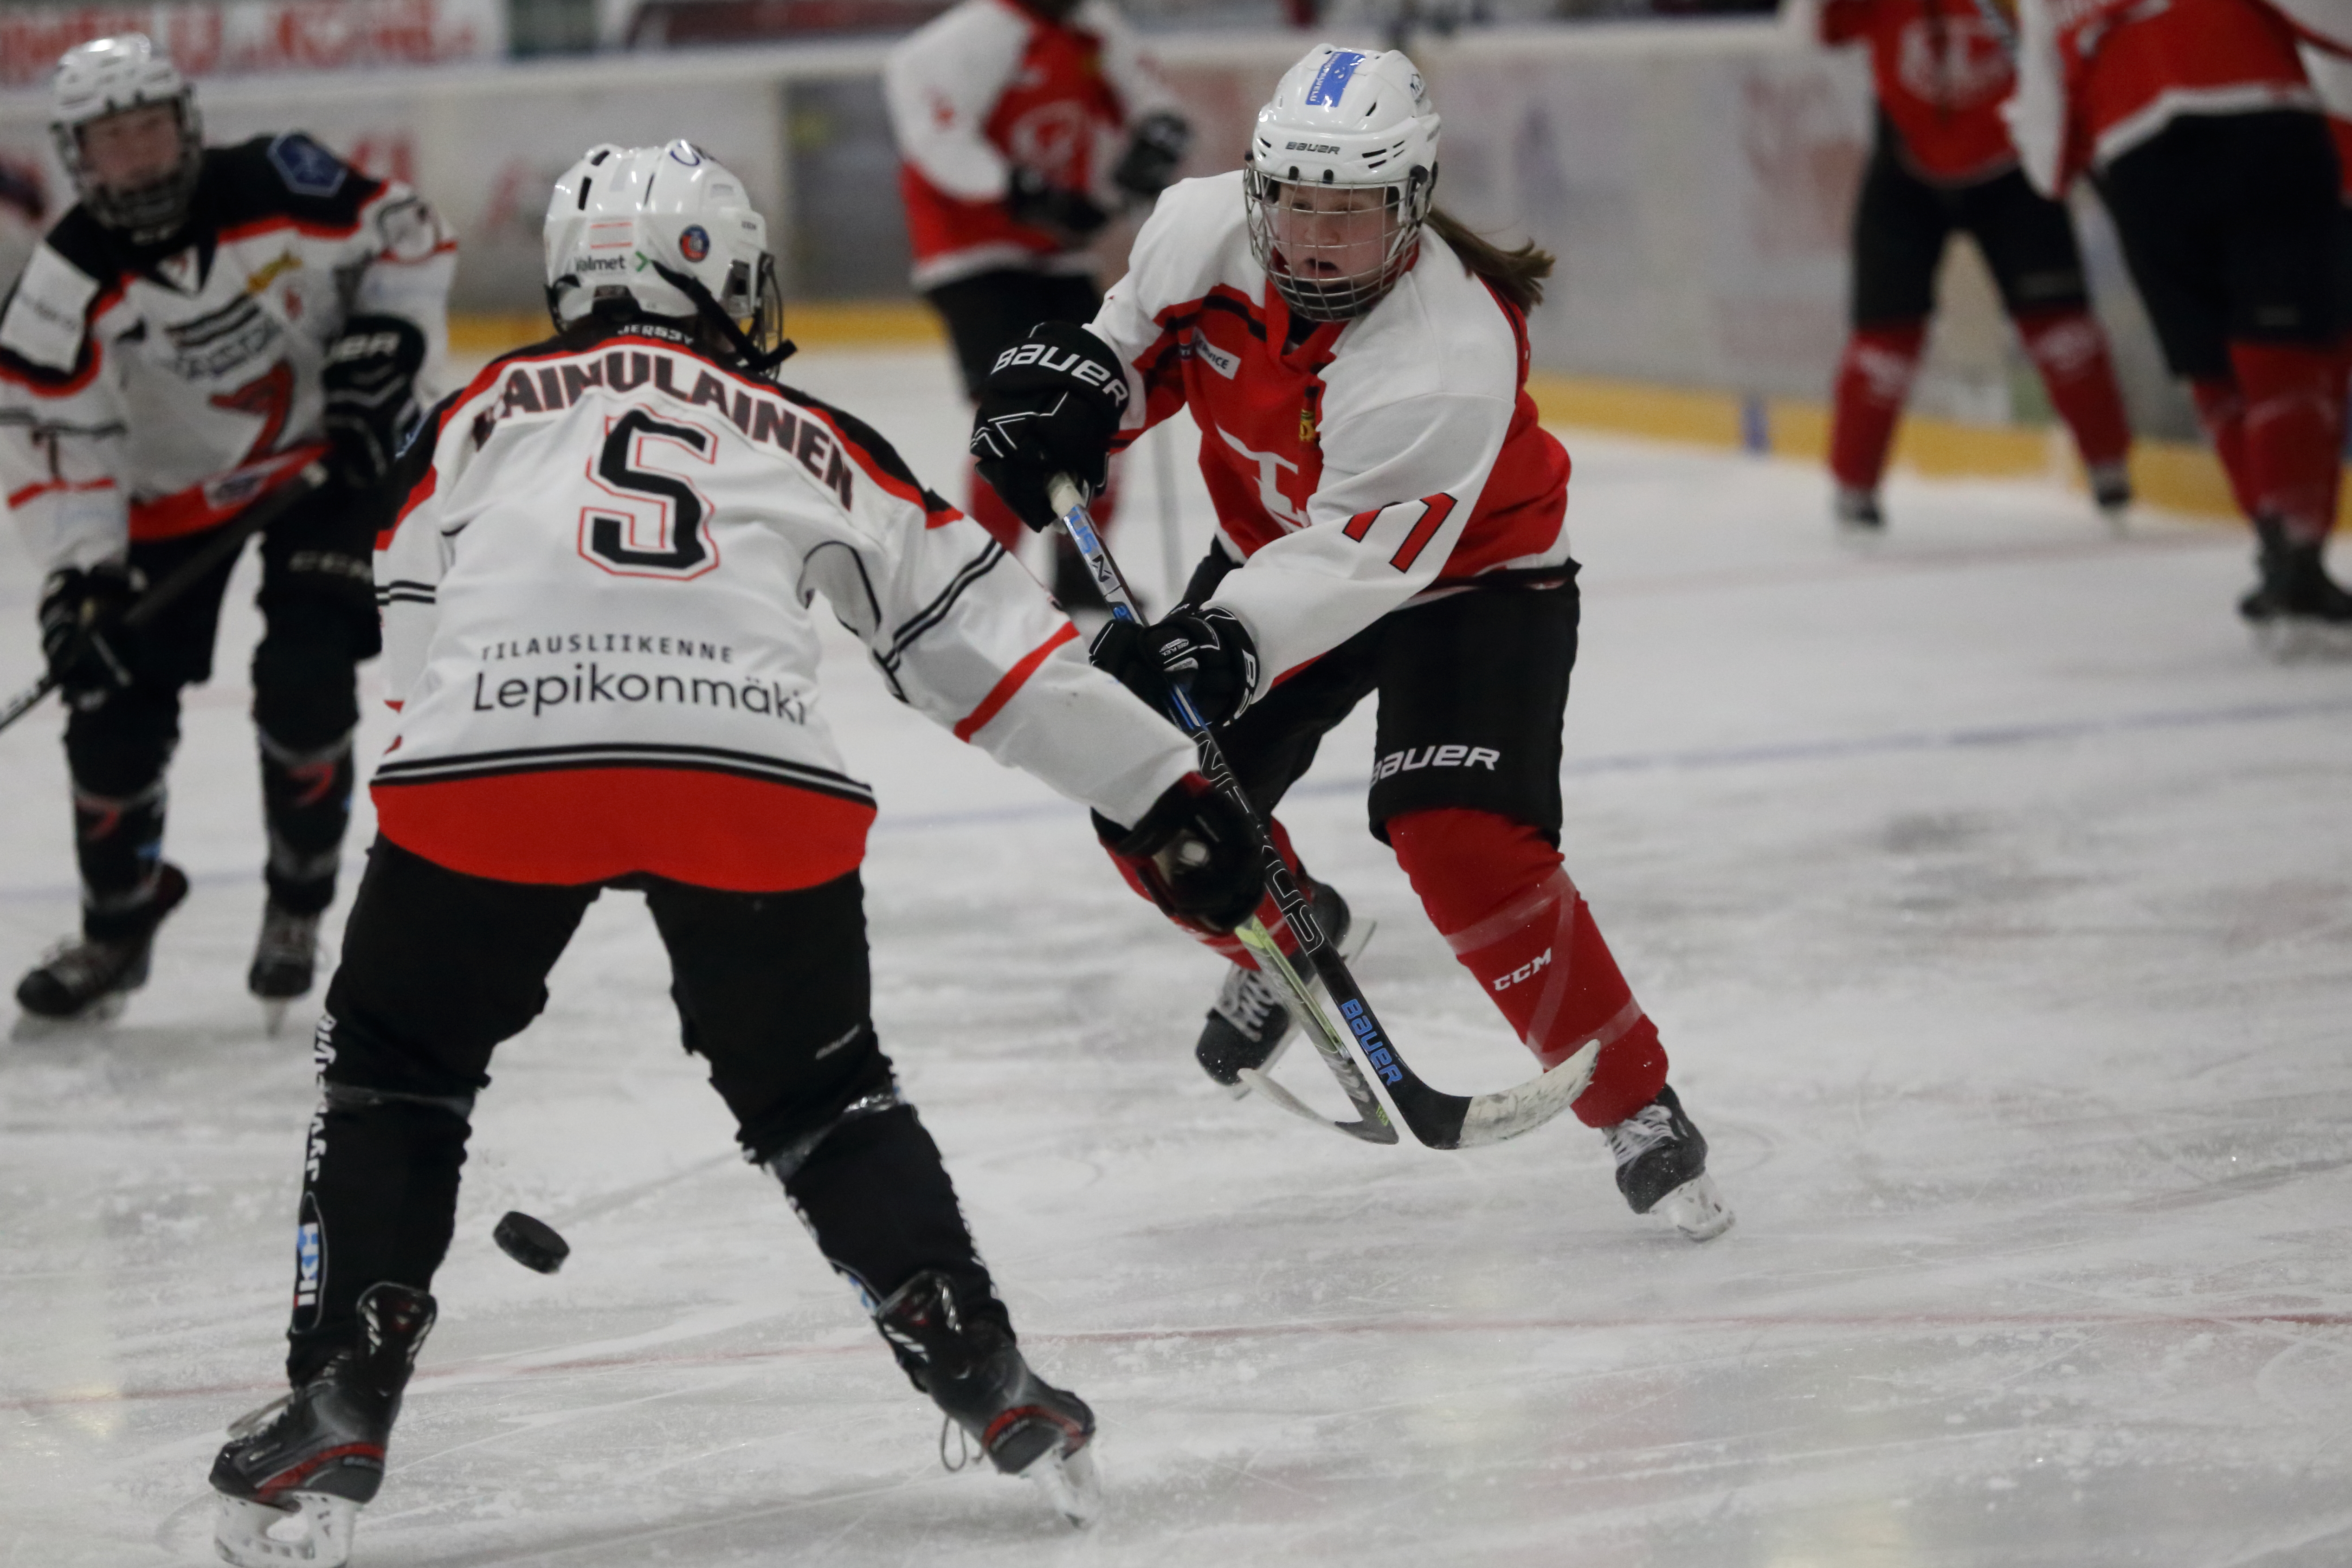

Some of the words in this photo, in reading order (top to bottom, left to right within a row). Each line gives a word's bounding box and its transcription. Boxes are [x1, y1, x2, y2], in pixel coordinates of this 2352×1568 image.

[991, 344, 1128, 407] BAUER
[483, 633, 732, 664] TILAUSLIIKENNE
[474, 662, 806, 725] Lepikonmäki
[1493, 947, 1552, 991] CCM
[1341, 999, 1403, 1086] BAUER
